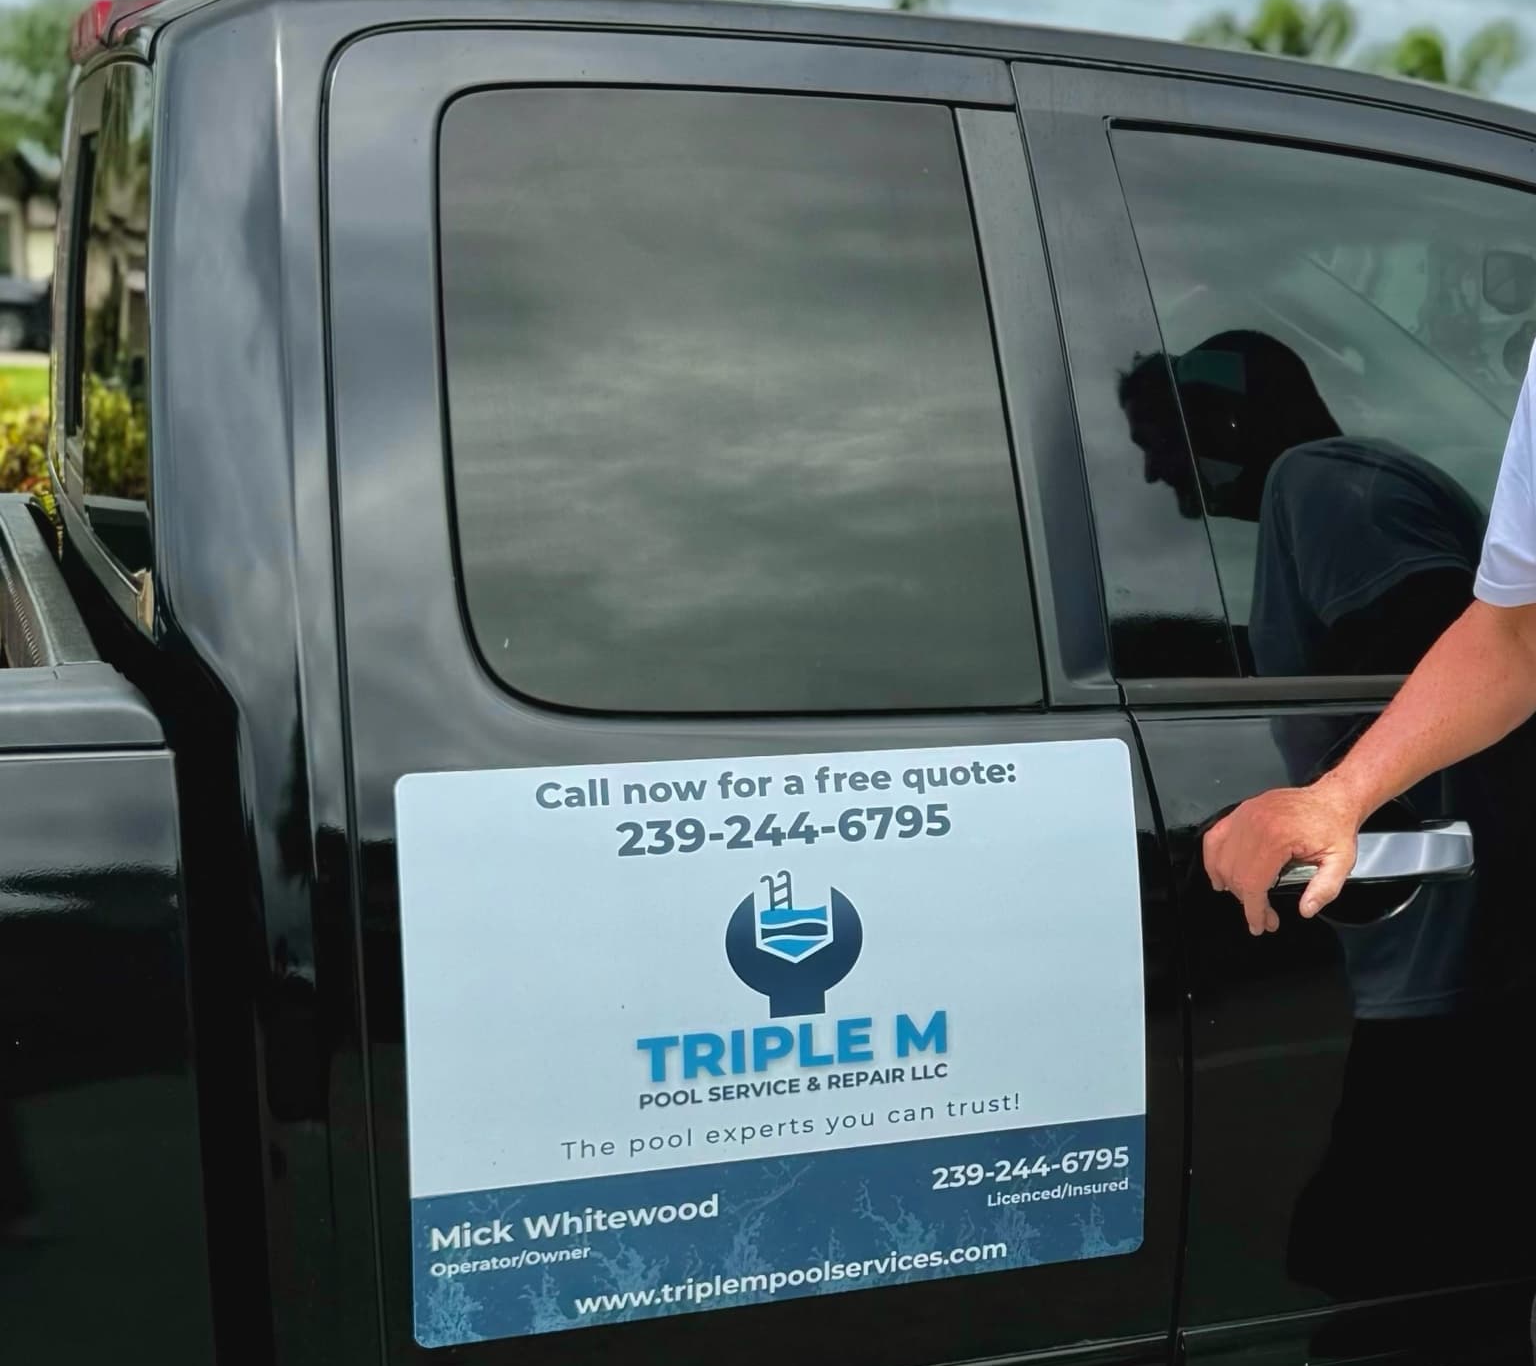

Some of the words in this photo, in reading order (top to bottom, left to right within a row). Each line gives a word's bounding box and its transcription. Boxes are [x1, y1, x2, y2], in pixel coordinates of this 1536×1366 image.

[535, 778, 610, 810] Call
[623, 779, 708, 806] now
[717, 771, 773, 800] for
[784, 774, 805, 796] a
[814, 766, 892, 794] free
[902, 761, 1017, 795] quote:
[616, 803, 952, 857] 239-244-6795
[636, 1016, 874, 1084] TRIPLE
[895, 1010, 949, 1059] M
[639, 1088, 704, 1110] POOL
[708, 1078, 801, 1103] SERVICE
[806, 1076, 821, 1092] &
[827, 1067, 905, 1091] REPAIR
[911, 1062, 948, 1082] LLC
[560, 1139, 615, 1161] The
[629, 1128, 692, 1158] pool
[705, 1119, 814, 1145] experts
[824, 1113, 874, 1136] you
[887, 1106, 934, 1124] can
[946, 1092, 1020, 1117] trust!
[932, 1147, 1129, 1191] 239-244-6795
[987, 1176, 1129, 1207] Licenced/Insured
[430, 1219, 515, 1252] Mick
[523, 1193, 720, 1241] Whitewood
[430, 1245, 592, 1279] Operator/Owner
[574, 1242, 1008, 1316] www.triplempoolservices.com
